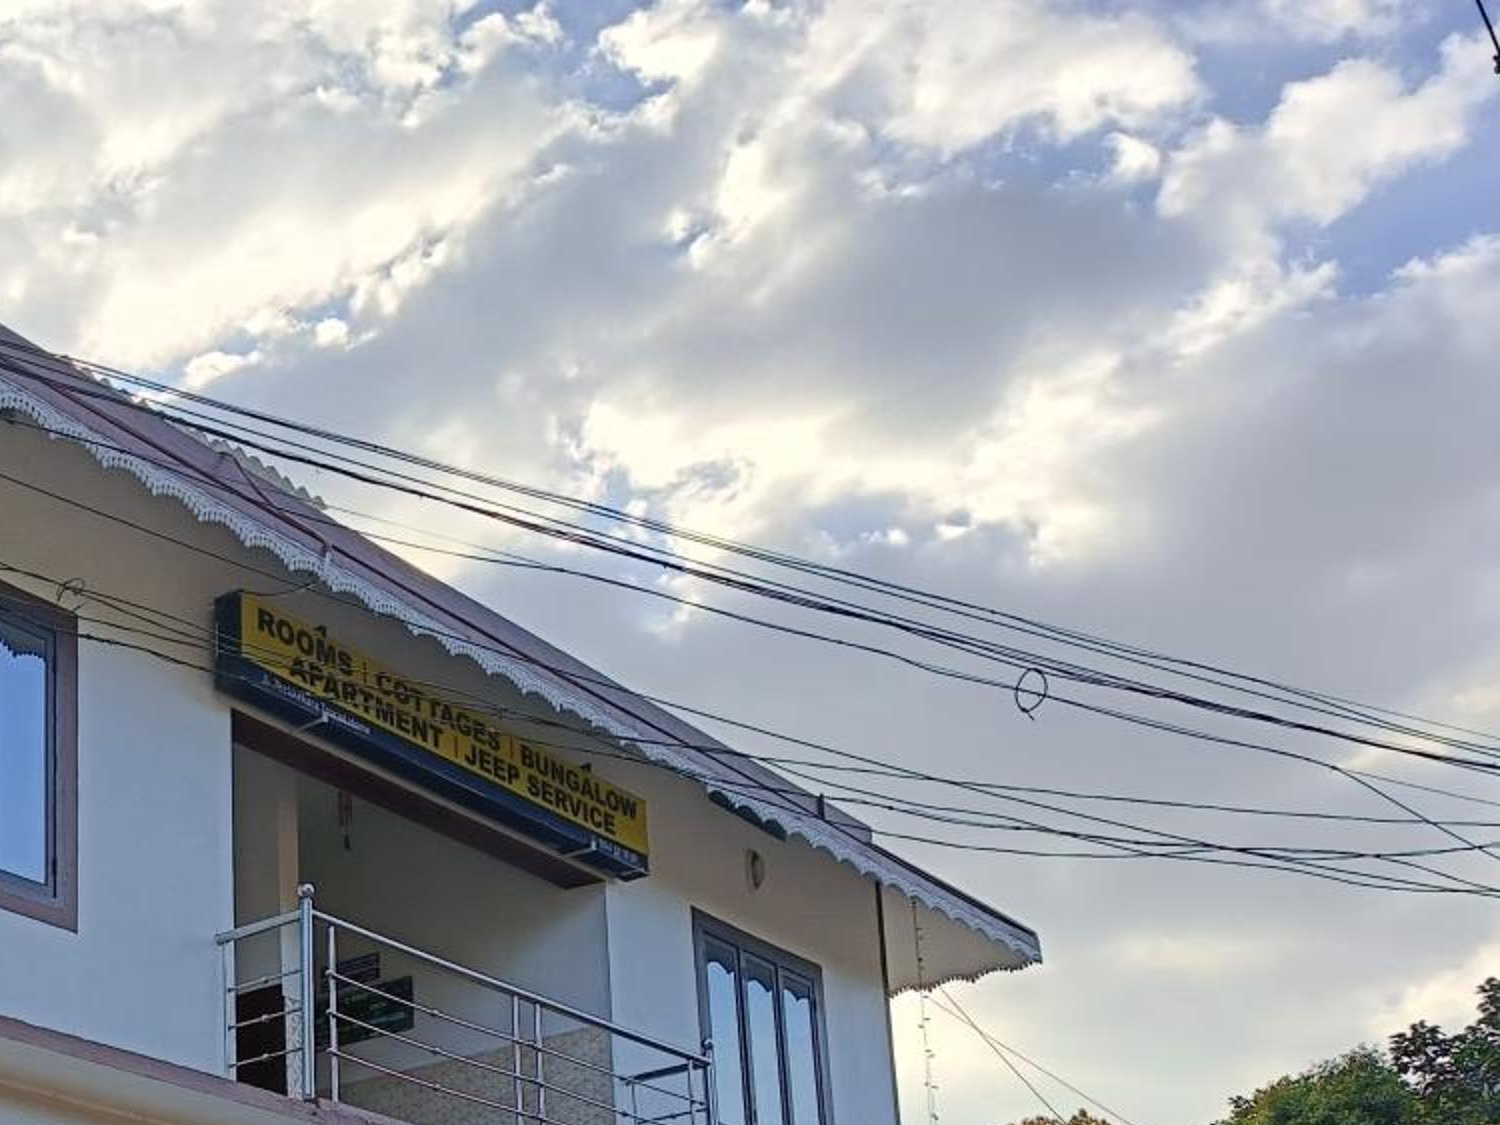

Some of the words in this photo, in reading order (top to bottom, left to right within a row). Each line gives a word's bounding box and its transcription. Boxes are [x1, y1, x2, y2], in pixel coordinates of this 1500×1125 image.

[258, 607, 353, 677] ROOMS
[519, 744, 637, 820] BUNGALOW
[464, 744, 520, 786] JEEP
[526, 773, 616, 836] SERVICE
